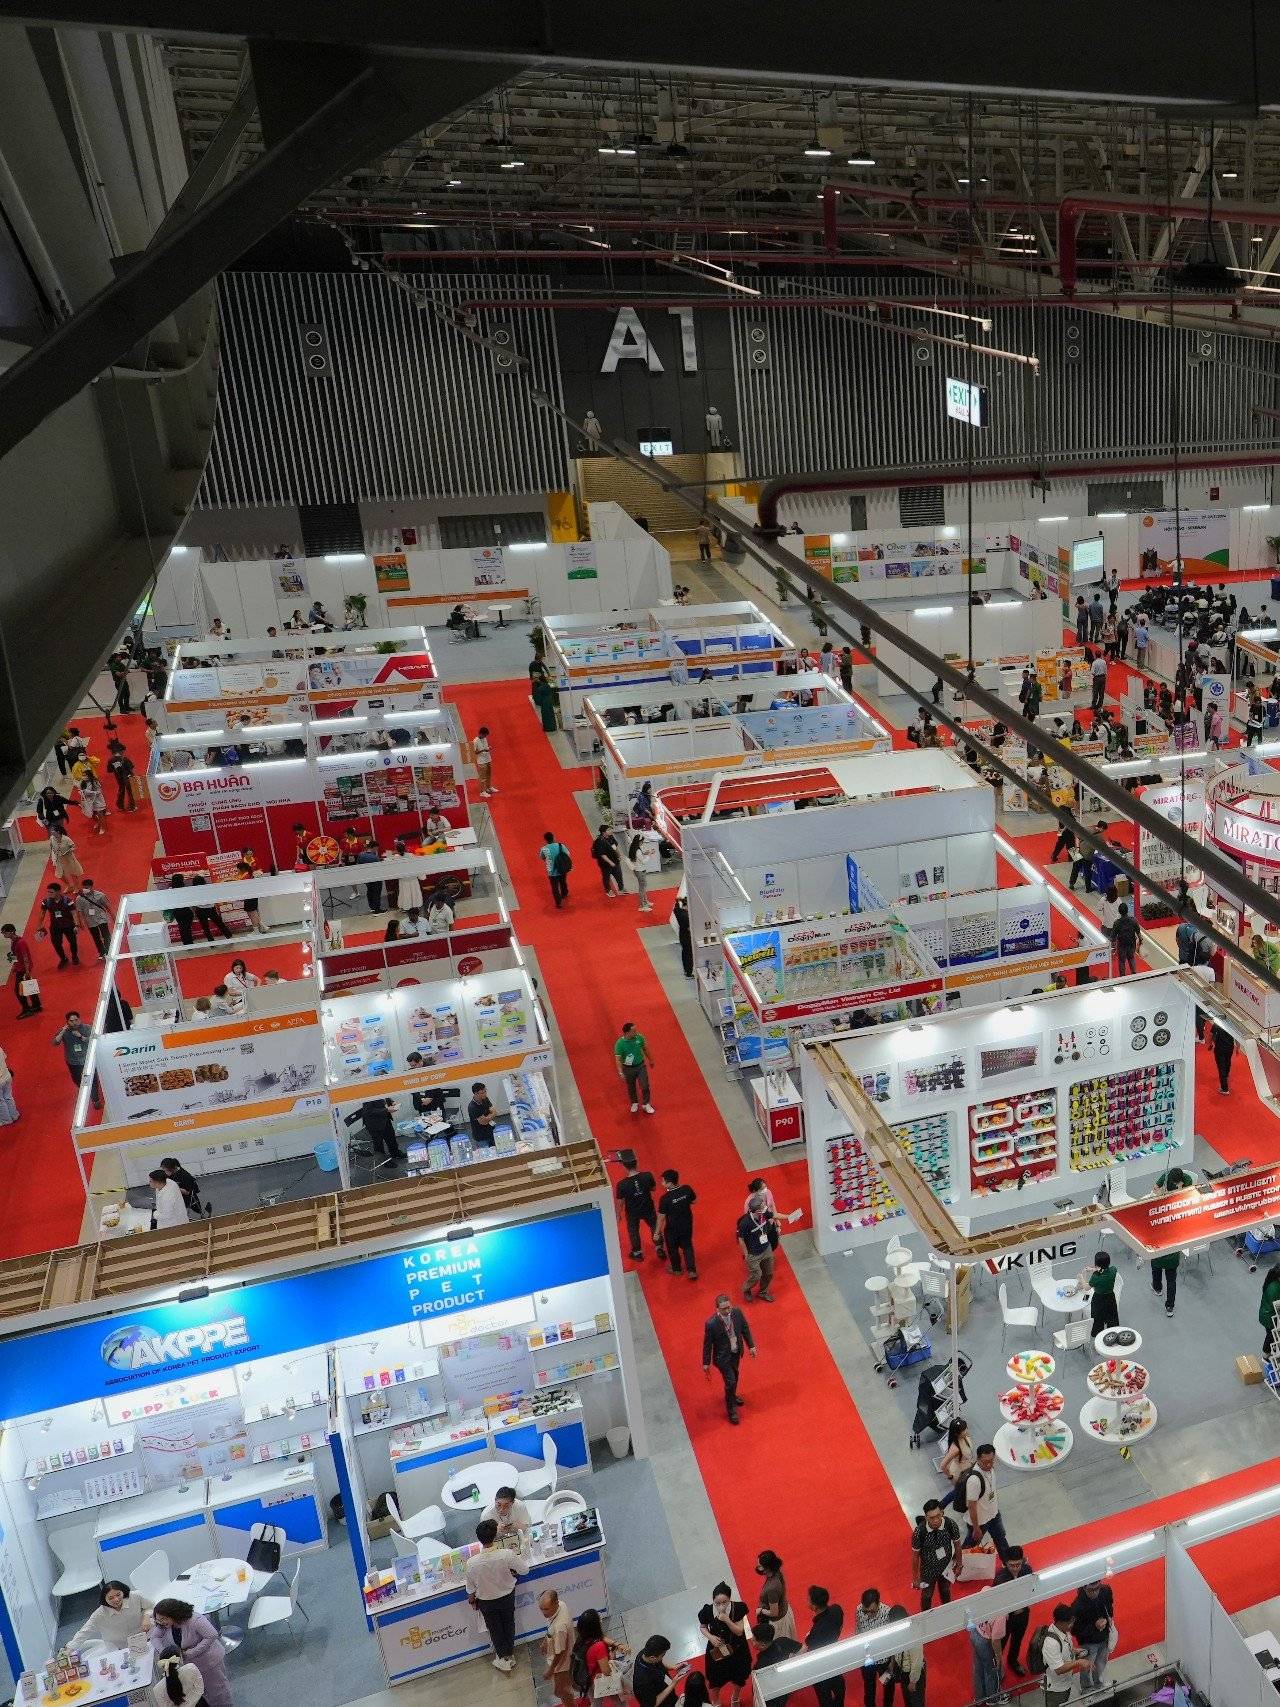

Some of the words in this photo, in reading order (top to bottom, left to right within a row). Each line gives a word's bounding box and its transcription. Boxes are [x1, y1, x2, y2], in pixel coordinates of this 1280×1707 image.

[600, 306, 699, 373] A1
[643, 443, 670, 453] EXIT
[183, 780, 204, 793] BA
[114, 1044, 156, 1058] Darin
[775, 1116, 794, 1128] P90
[1227, 1175, 1277, 1195] INTELLIGENT
[403, 1243, 479, 1269] KOREA
[985, 1241, 1078, 1277] VKING
[406, 1258, 482, 1285] PREMIUM
[411, 1290, 485, 1317] PRODUCT
[130, 1316, 250, 1370] AKPPE
[152, 1367, 161, 1377] OF
[201, 1352, 233, 1365] PRODUCT
[234, 1344, 262, 1356] EXPORT
[121, 1401, 175, 1420] PUPPY
[179, 1389, 219, 1406] LUCK
[425, 1627, 469, 1646] doctor
